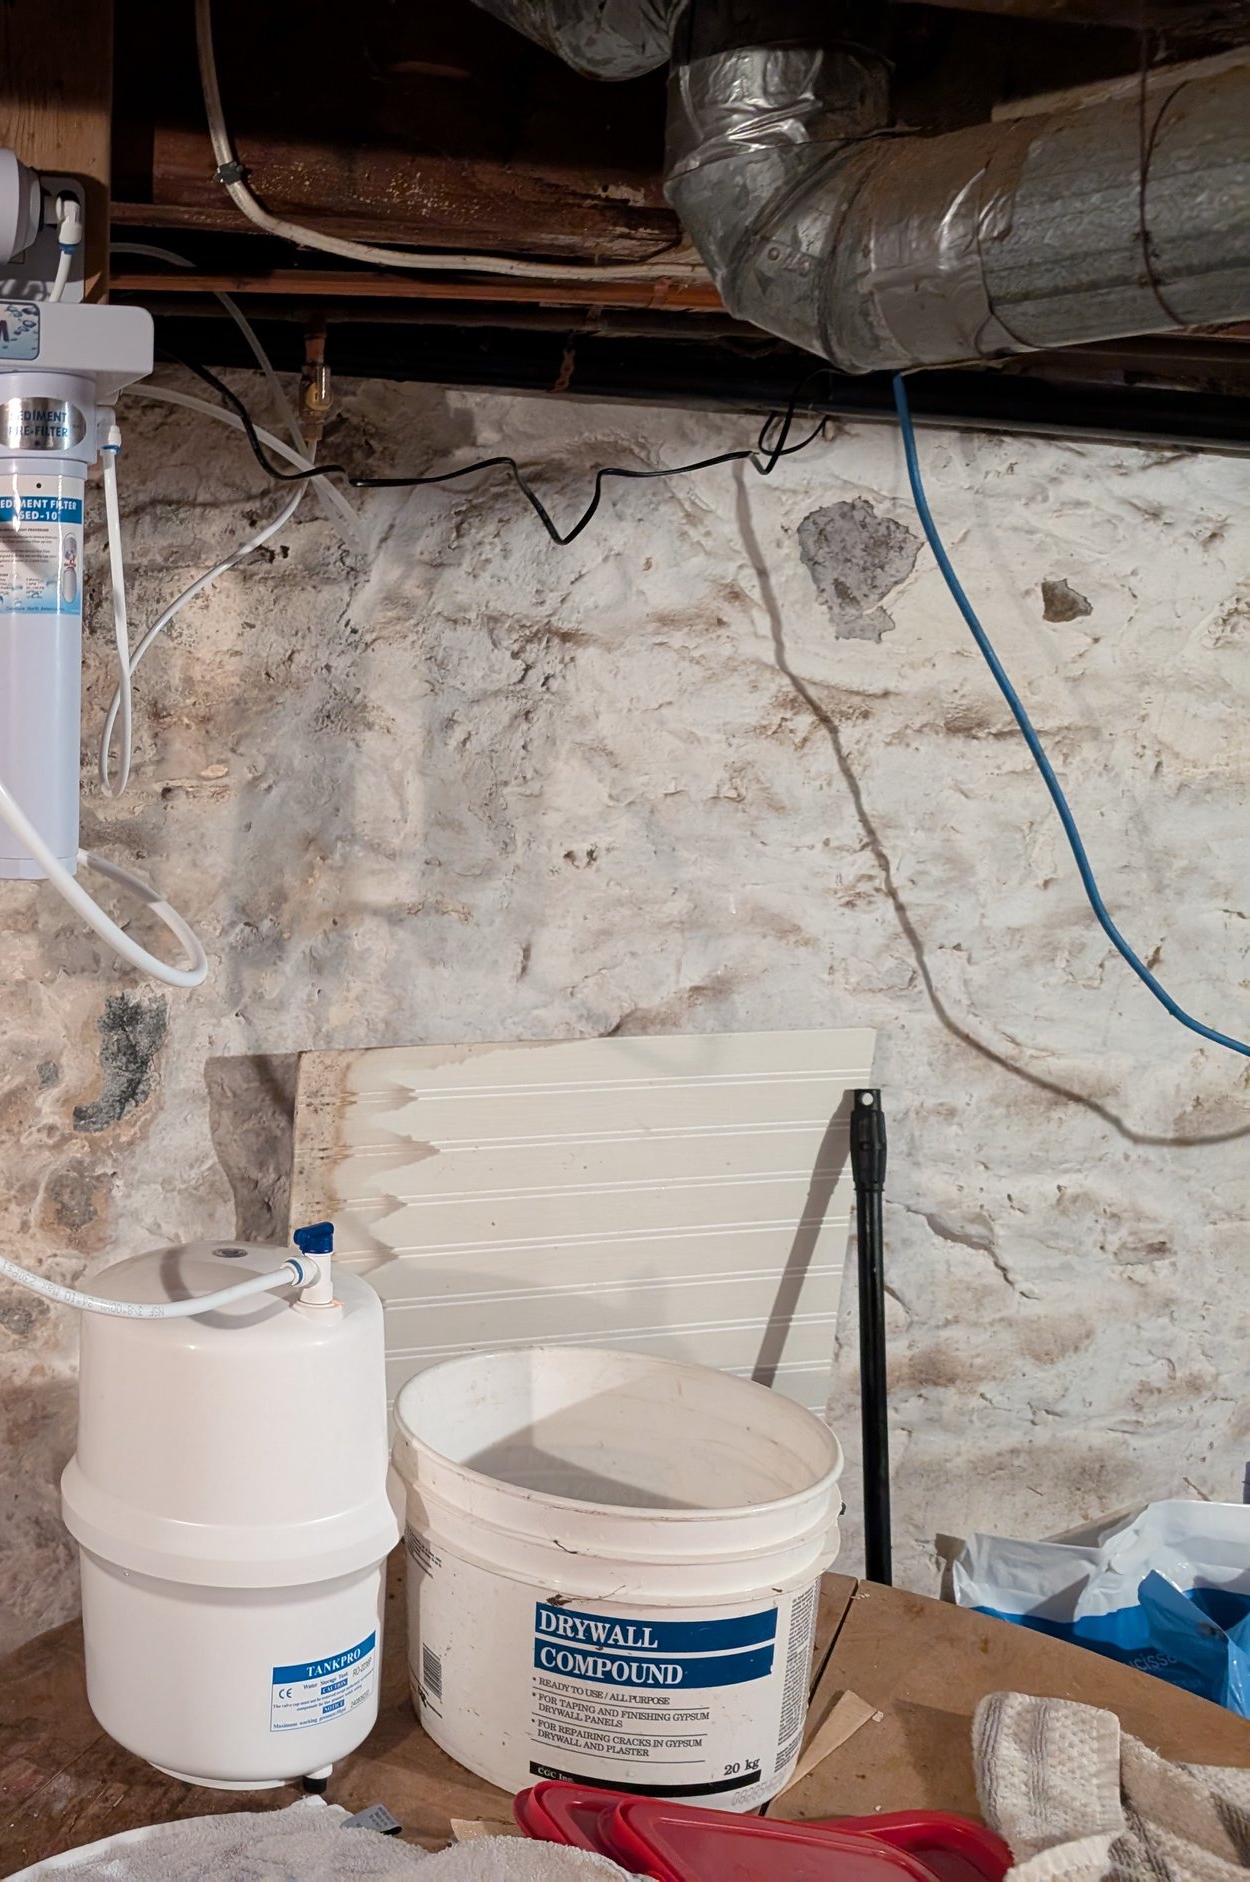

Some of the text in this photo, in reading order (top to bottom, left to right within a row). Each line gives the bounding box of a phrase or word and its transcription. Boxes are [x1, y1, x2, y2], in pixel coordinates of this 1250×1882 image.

[9, 410, 67, 423] EDIMENT
[19, 510, 58, 520] SED-10
[40, 1280, 61, 1298] Max
[539, 1609, 658, 1649] DRYWALL
[307, 1648, 361, 1677] TANKPRO
[540, 1646, 683, 1685] COMPOUND
[539, 1677, 570, 1693] READY
[571, 1686, 585, 1696] TO
[585, 1688, 603, 1699] USE
[609, 1693, 628, 1703] ALL
[628, 1695, 670, 1705] PURPOSE
[538, 1693, 710, 1722] FOR TAPING AND FINISHING GYPSUM
[538, 1702, 623, 1728] DRYWALL PANELS
[537, 1729, 650, 1757] DRYWALL AND PLASTER
[538, 1718, 703, 1748] FOR REPAIRING CRACKS IN GYPSUM
[537, 1766, 557, 1779] CGC
[724, 1758, 761, 1776] 20 kg
